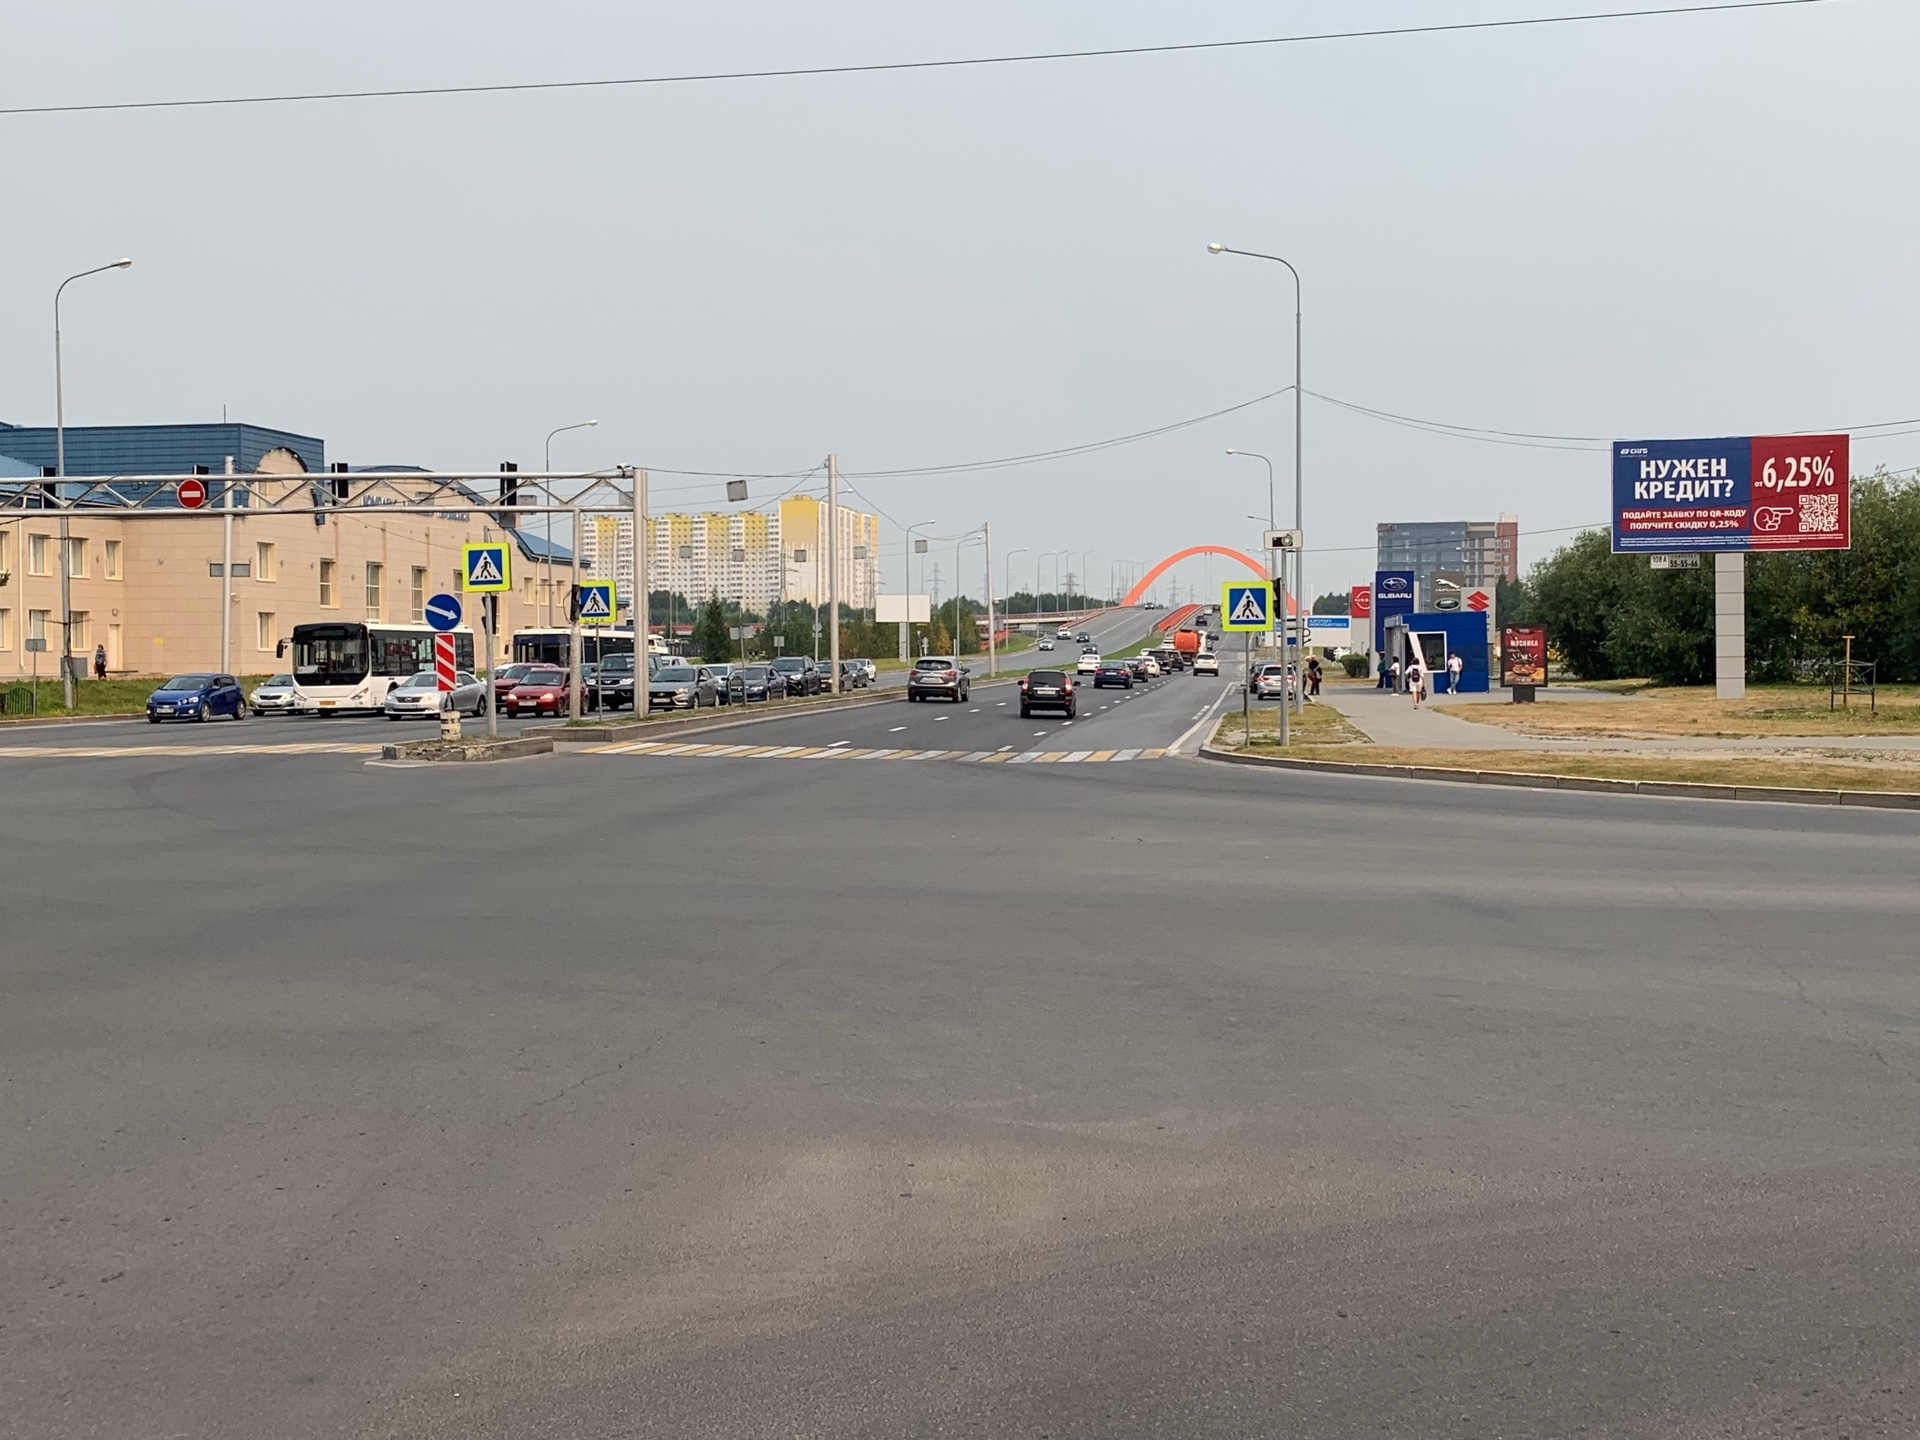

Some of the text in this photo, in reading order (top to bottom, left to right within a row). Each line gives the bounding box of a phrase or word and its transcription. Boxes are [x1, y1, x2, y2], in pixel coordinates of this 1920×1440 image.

[1640, 458, 1727, 479] НУЖЕН
[1634, 479, 1735, 502] КРЕДИТ?
[1622, 509, 1746, 520] ПОДАЙТЕ ЗАЯВКУ ПО QR-КОДУ
[1630, 520, 1739, 530] ПОЛУЧИТЕ СКИДКУ 0,25%
